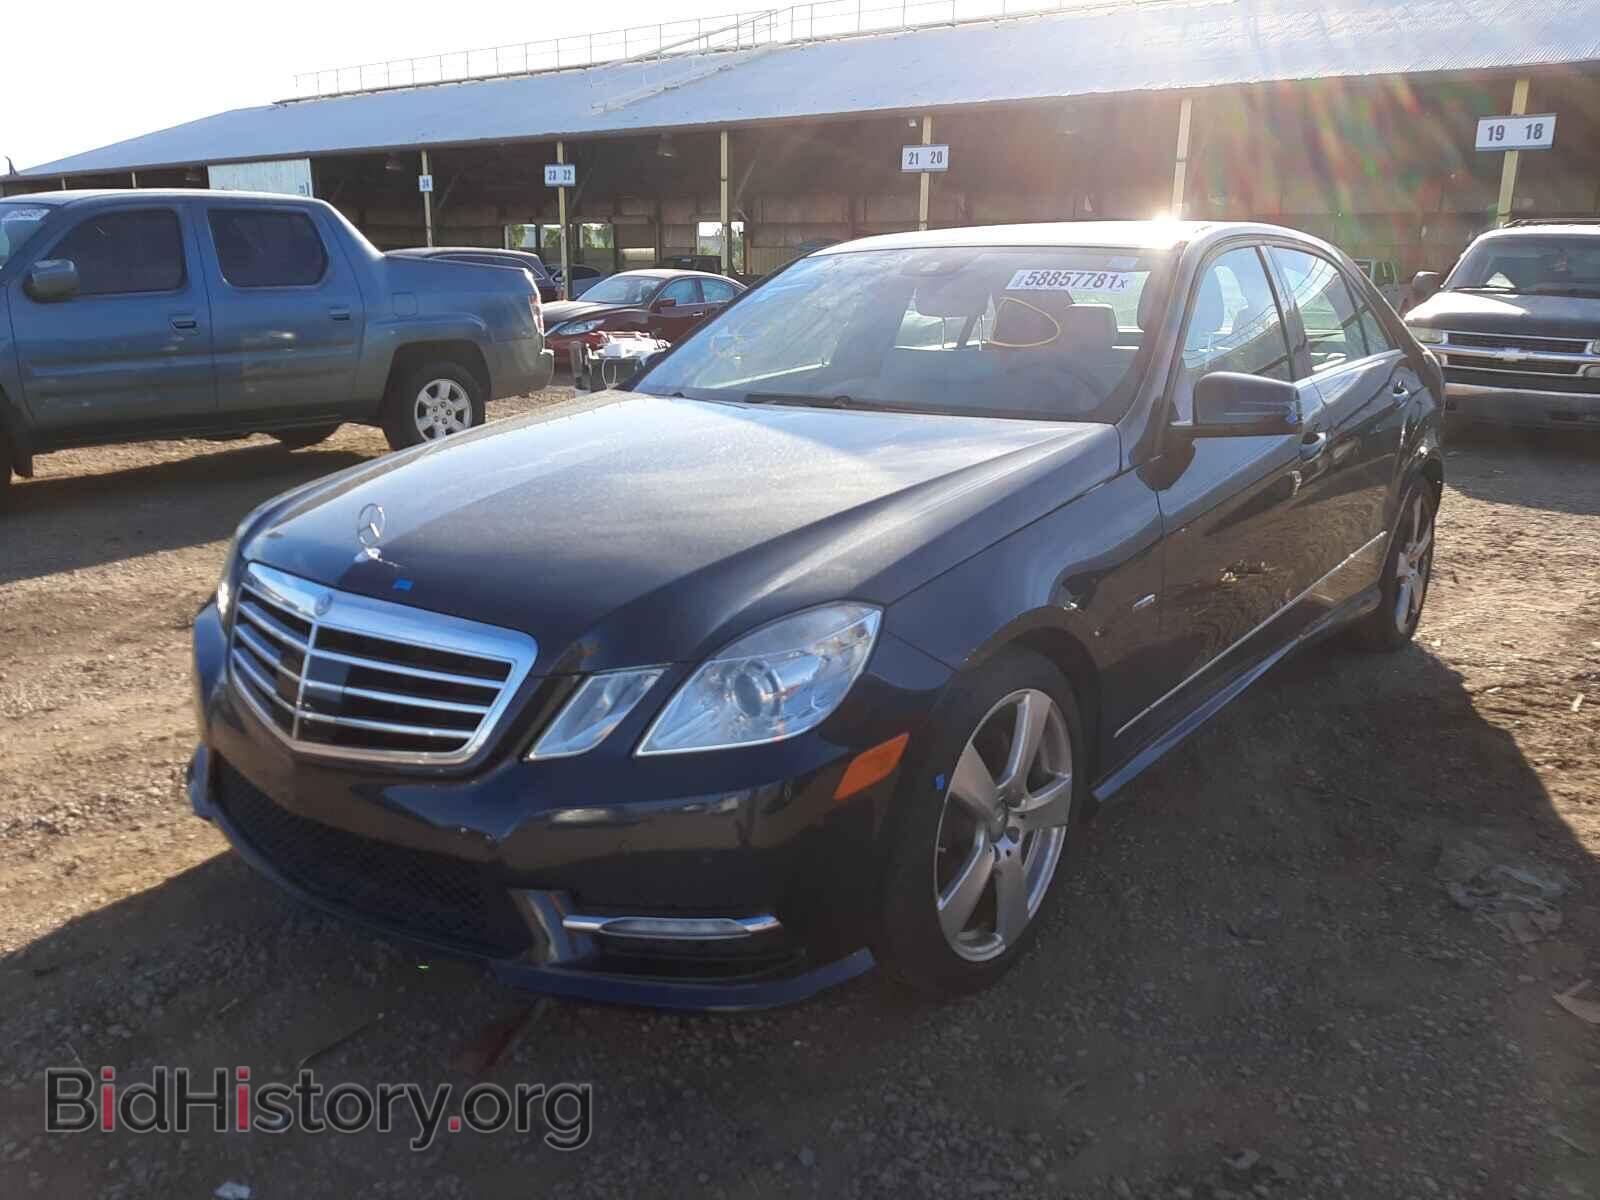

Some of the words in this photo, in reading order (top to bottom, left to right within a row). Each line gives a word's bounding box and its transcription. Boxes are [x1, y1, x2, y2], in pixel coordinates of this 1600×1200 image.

[1487, 124, 1505, 142] 19
[1525, 122, 1544, 141] 18
[908, 151, 919, 165] 21
[930, 151, 943, 164] 20
